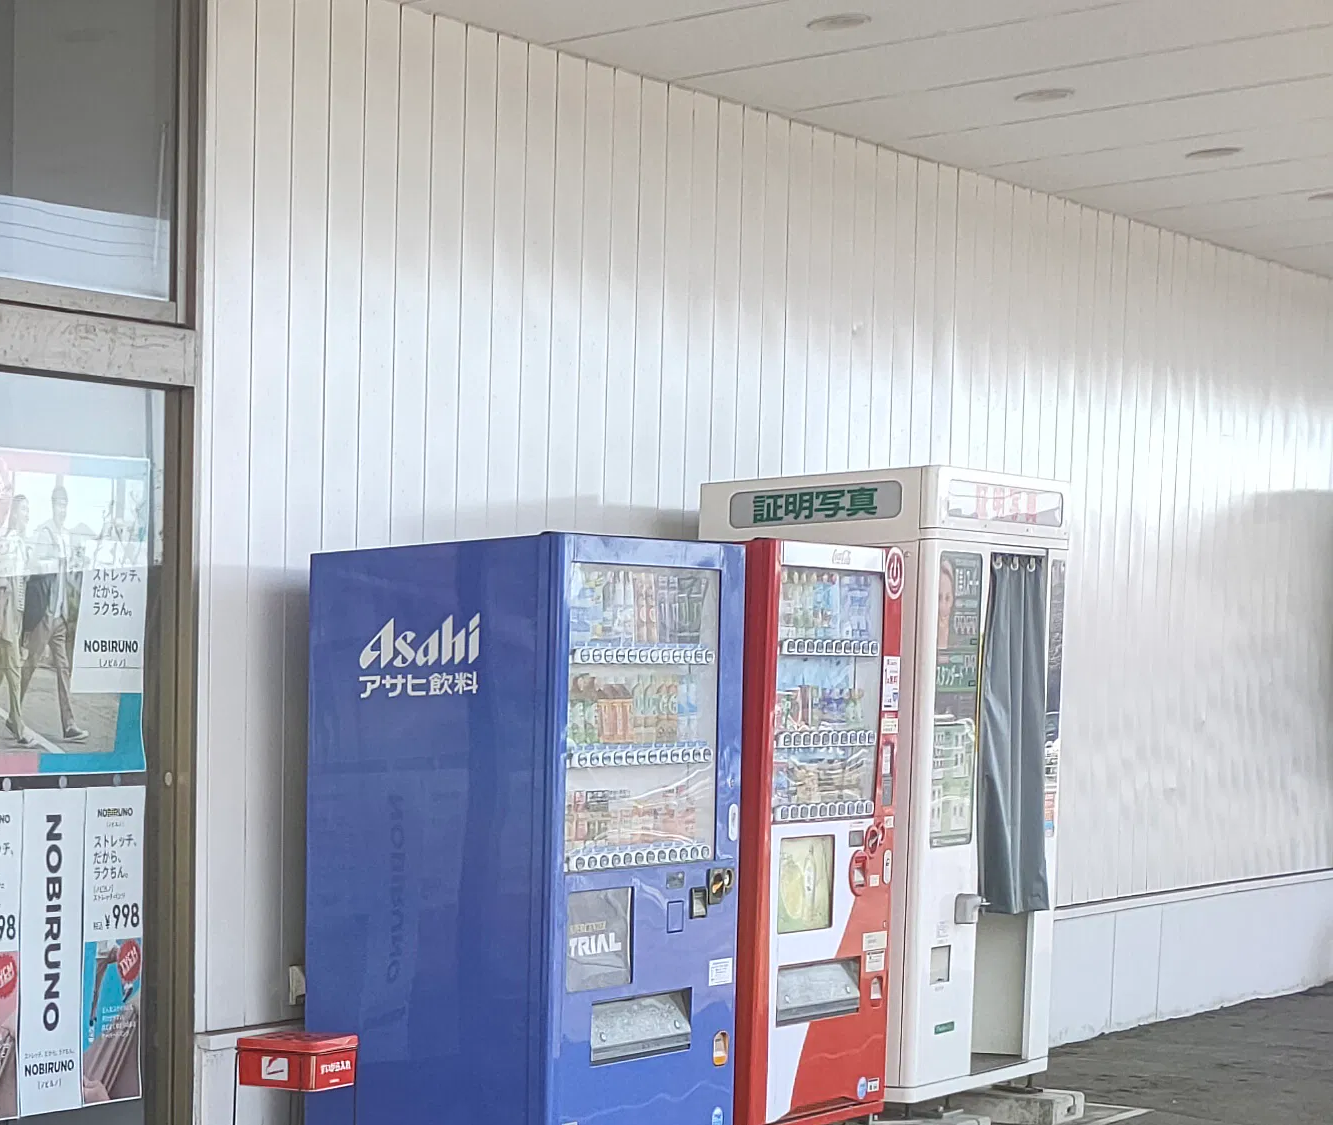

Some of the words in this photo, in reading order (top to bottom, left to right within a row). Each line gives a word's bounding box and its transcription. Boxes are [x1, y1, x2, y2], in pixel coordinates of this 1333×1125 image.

[753, 486, 878, 524] 証明写真
[92, 568, 142, 583] ストレッチ、
[92, 585, 124, 599] だから、
[92, 602, 132, 617] ラクちん。
[84, 639, 138, 653] NOBIRUNO
[359, 612, 481, 669] Asahi
[358, 671, 478, 699] アサヒ飲料
[93, 834, 137, 848] ストレッチ、
[93, 851, 121, 865] だから、
[93, 867, 128, 880] ラクちん。
[43, 814, 63, 1032] NOBIRUNO
[569, 932, 622, 957] TRIAL
[24, 1059, 74, 1077] NOBIRUNO
